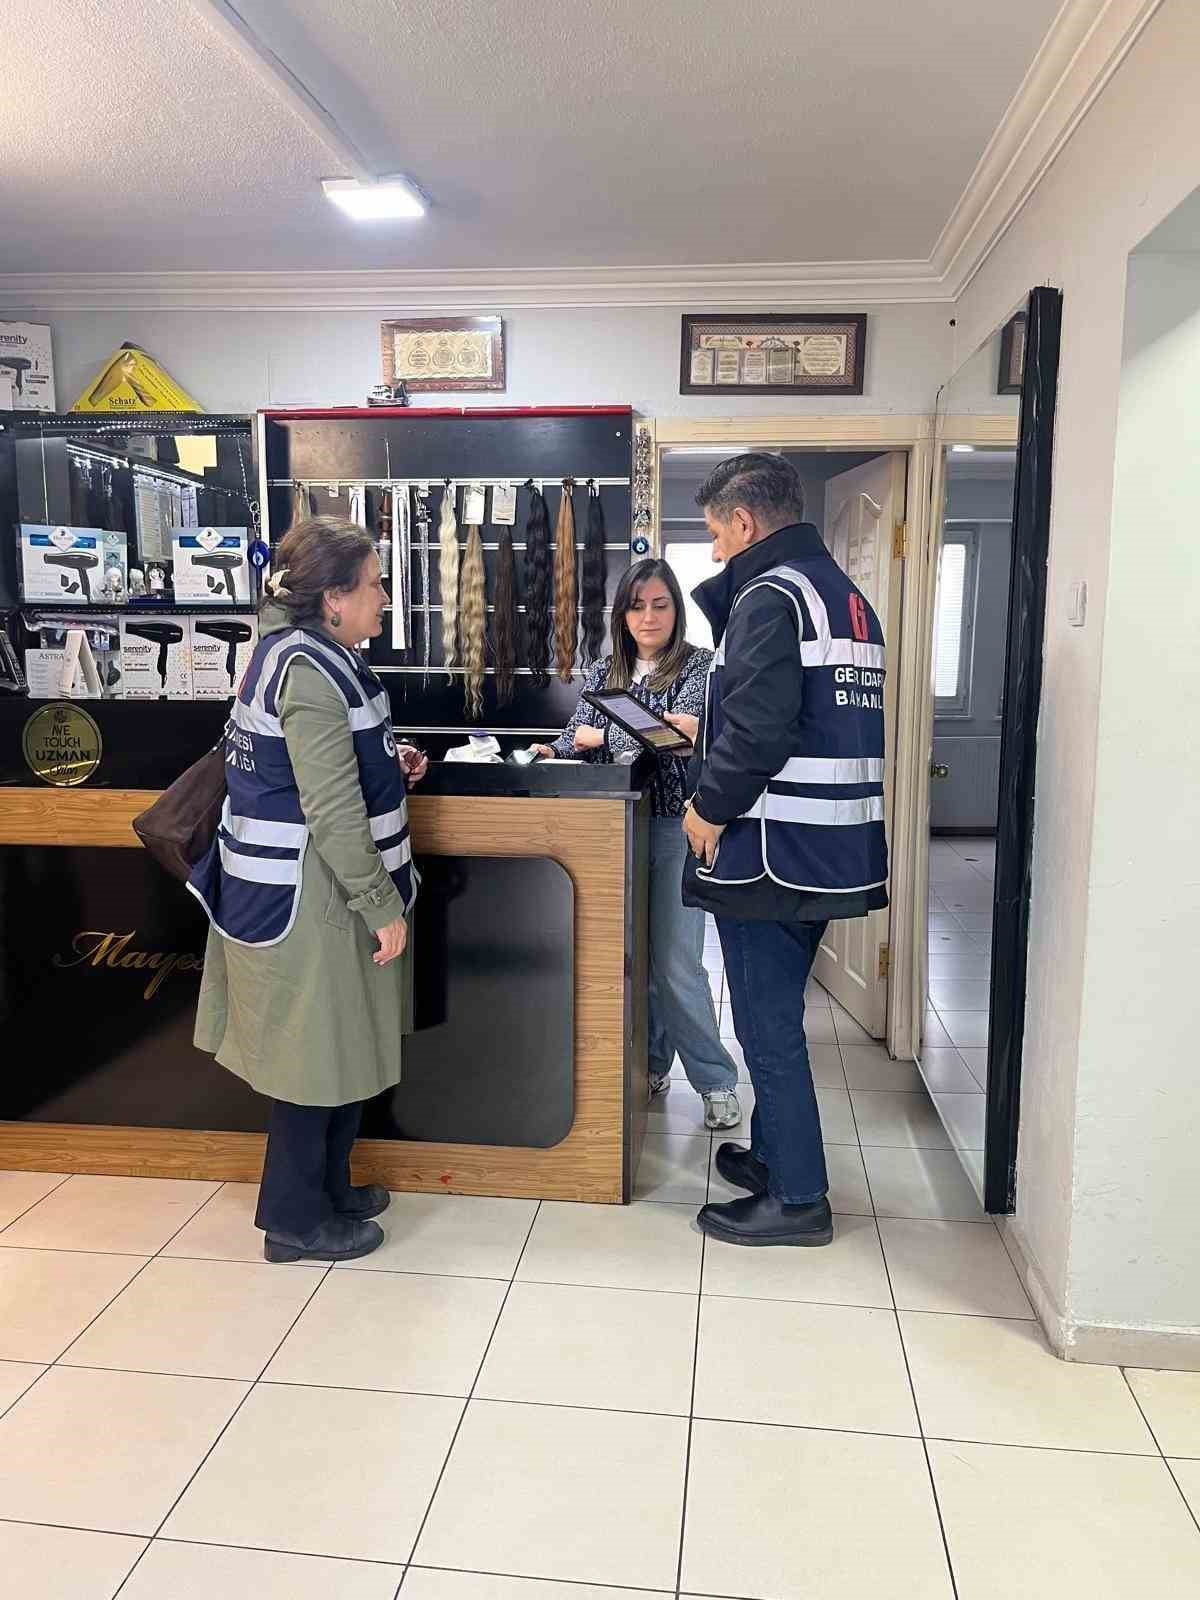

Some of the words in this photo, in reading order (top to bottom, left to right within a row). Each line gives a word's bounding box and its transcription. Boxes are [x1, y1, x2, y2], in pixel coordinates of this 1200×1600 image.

[123, 645, 152, 654] serenity
[193, 644, 221, 653] serenity
[43, 736, 81, 748] TOUCH
[36, 750, 90, 761] UZMAN
